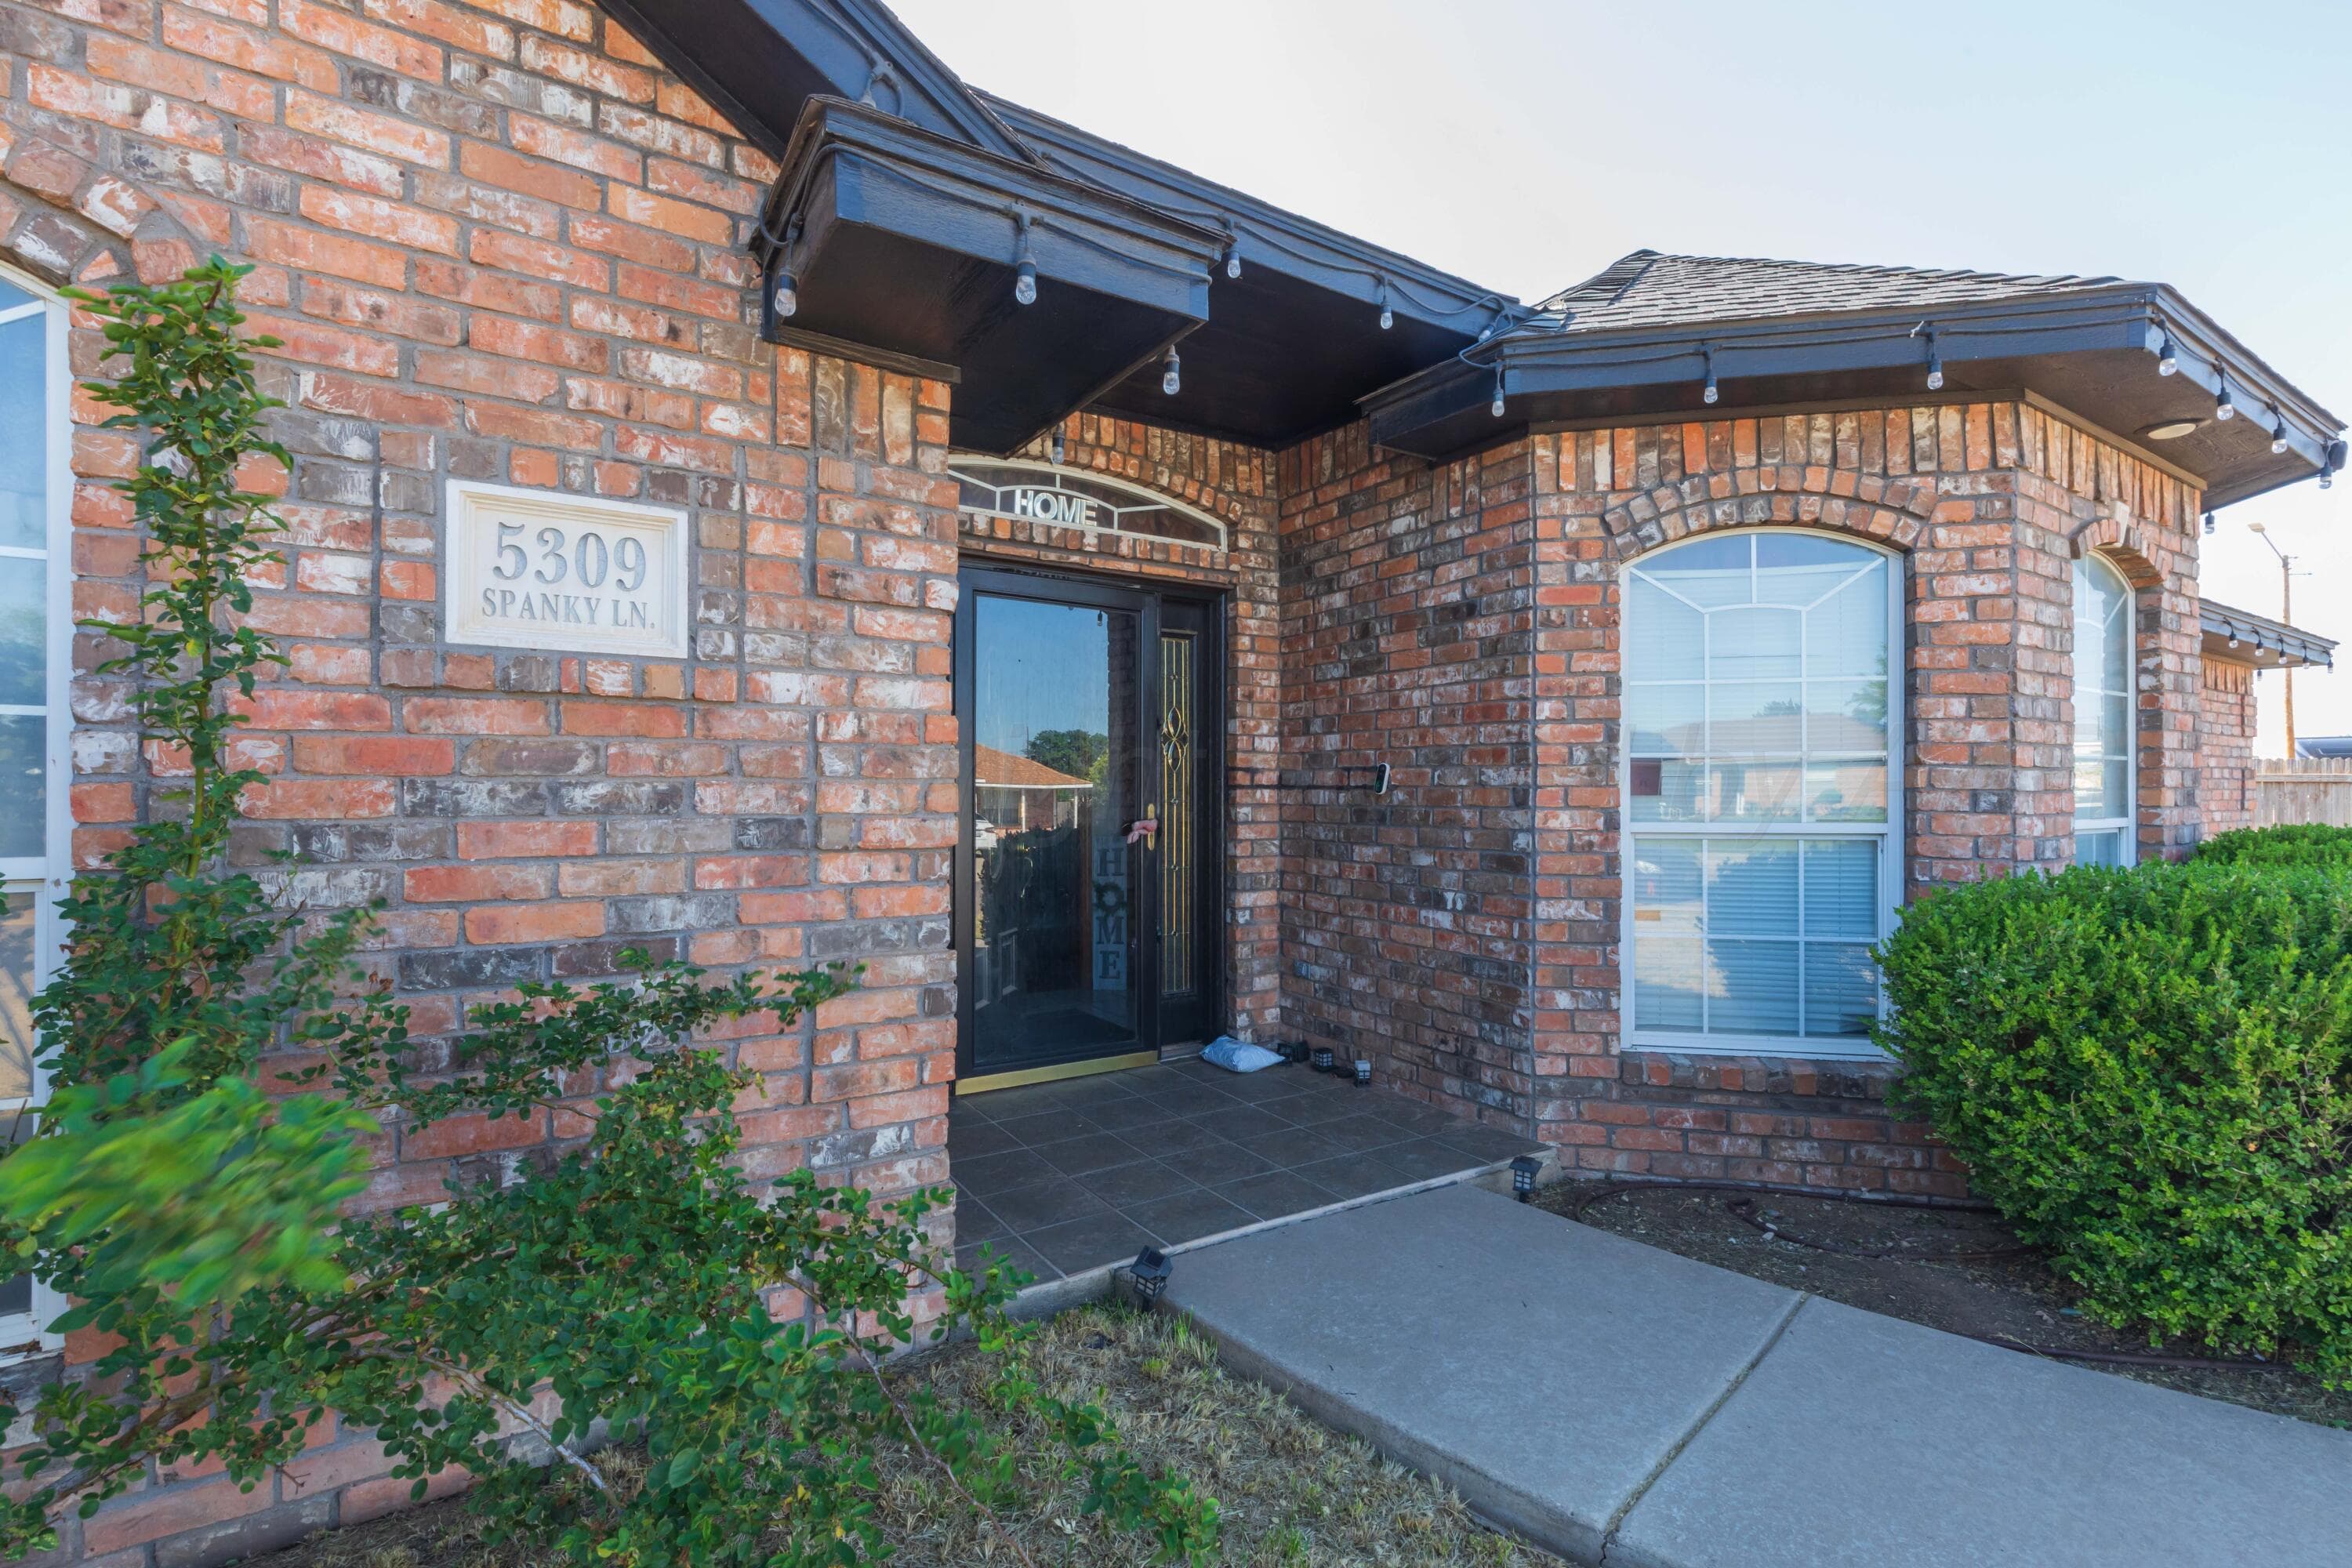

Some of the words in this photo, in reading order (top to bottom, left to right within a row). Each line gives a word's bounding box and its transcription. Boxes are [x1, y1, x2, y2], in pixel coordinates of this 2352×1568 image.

[1014, 488, 1098, 528] HOME
[492, 521, 646, 592] 5309
[482, 587, 601, 625] SPANKY
[611, 599, 655, 630] LN.
